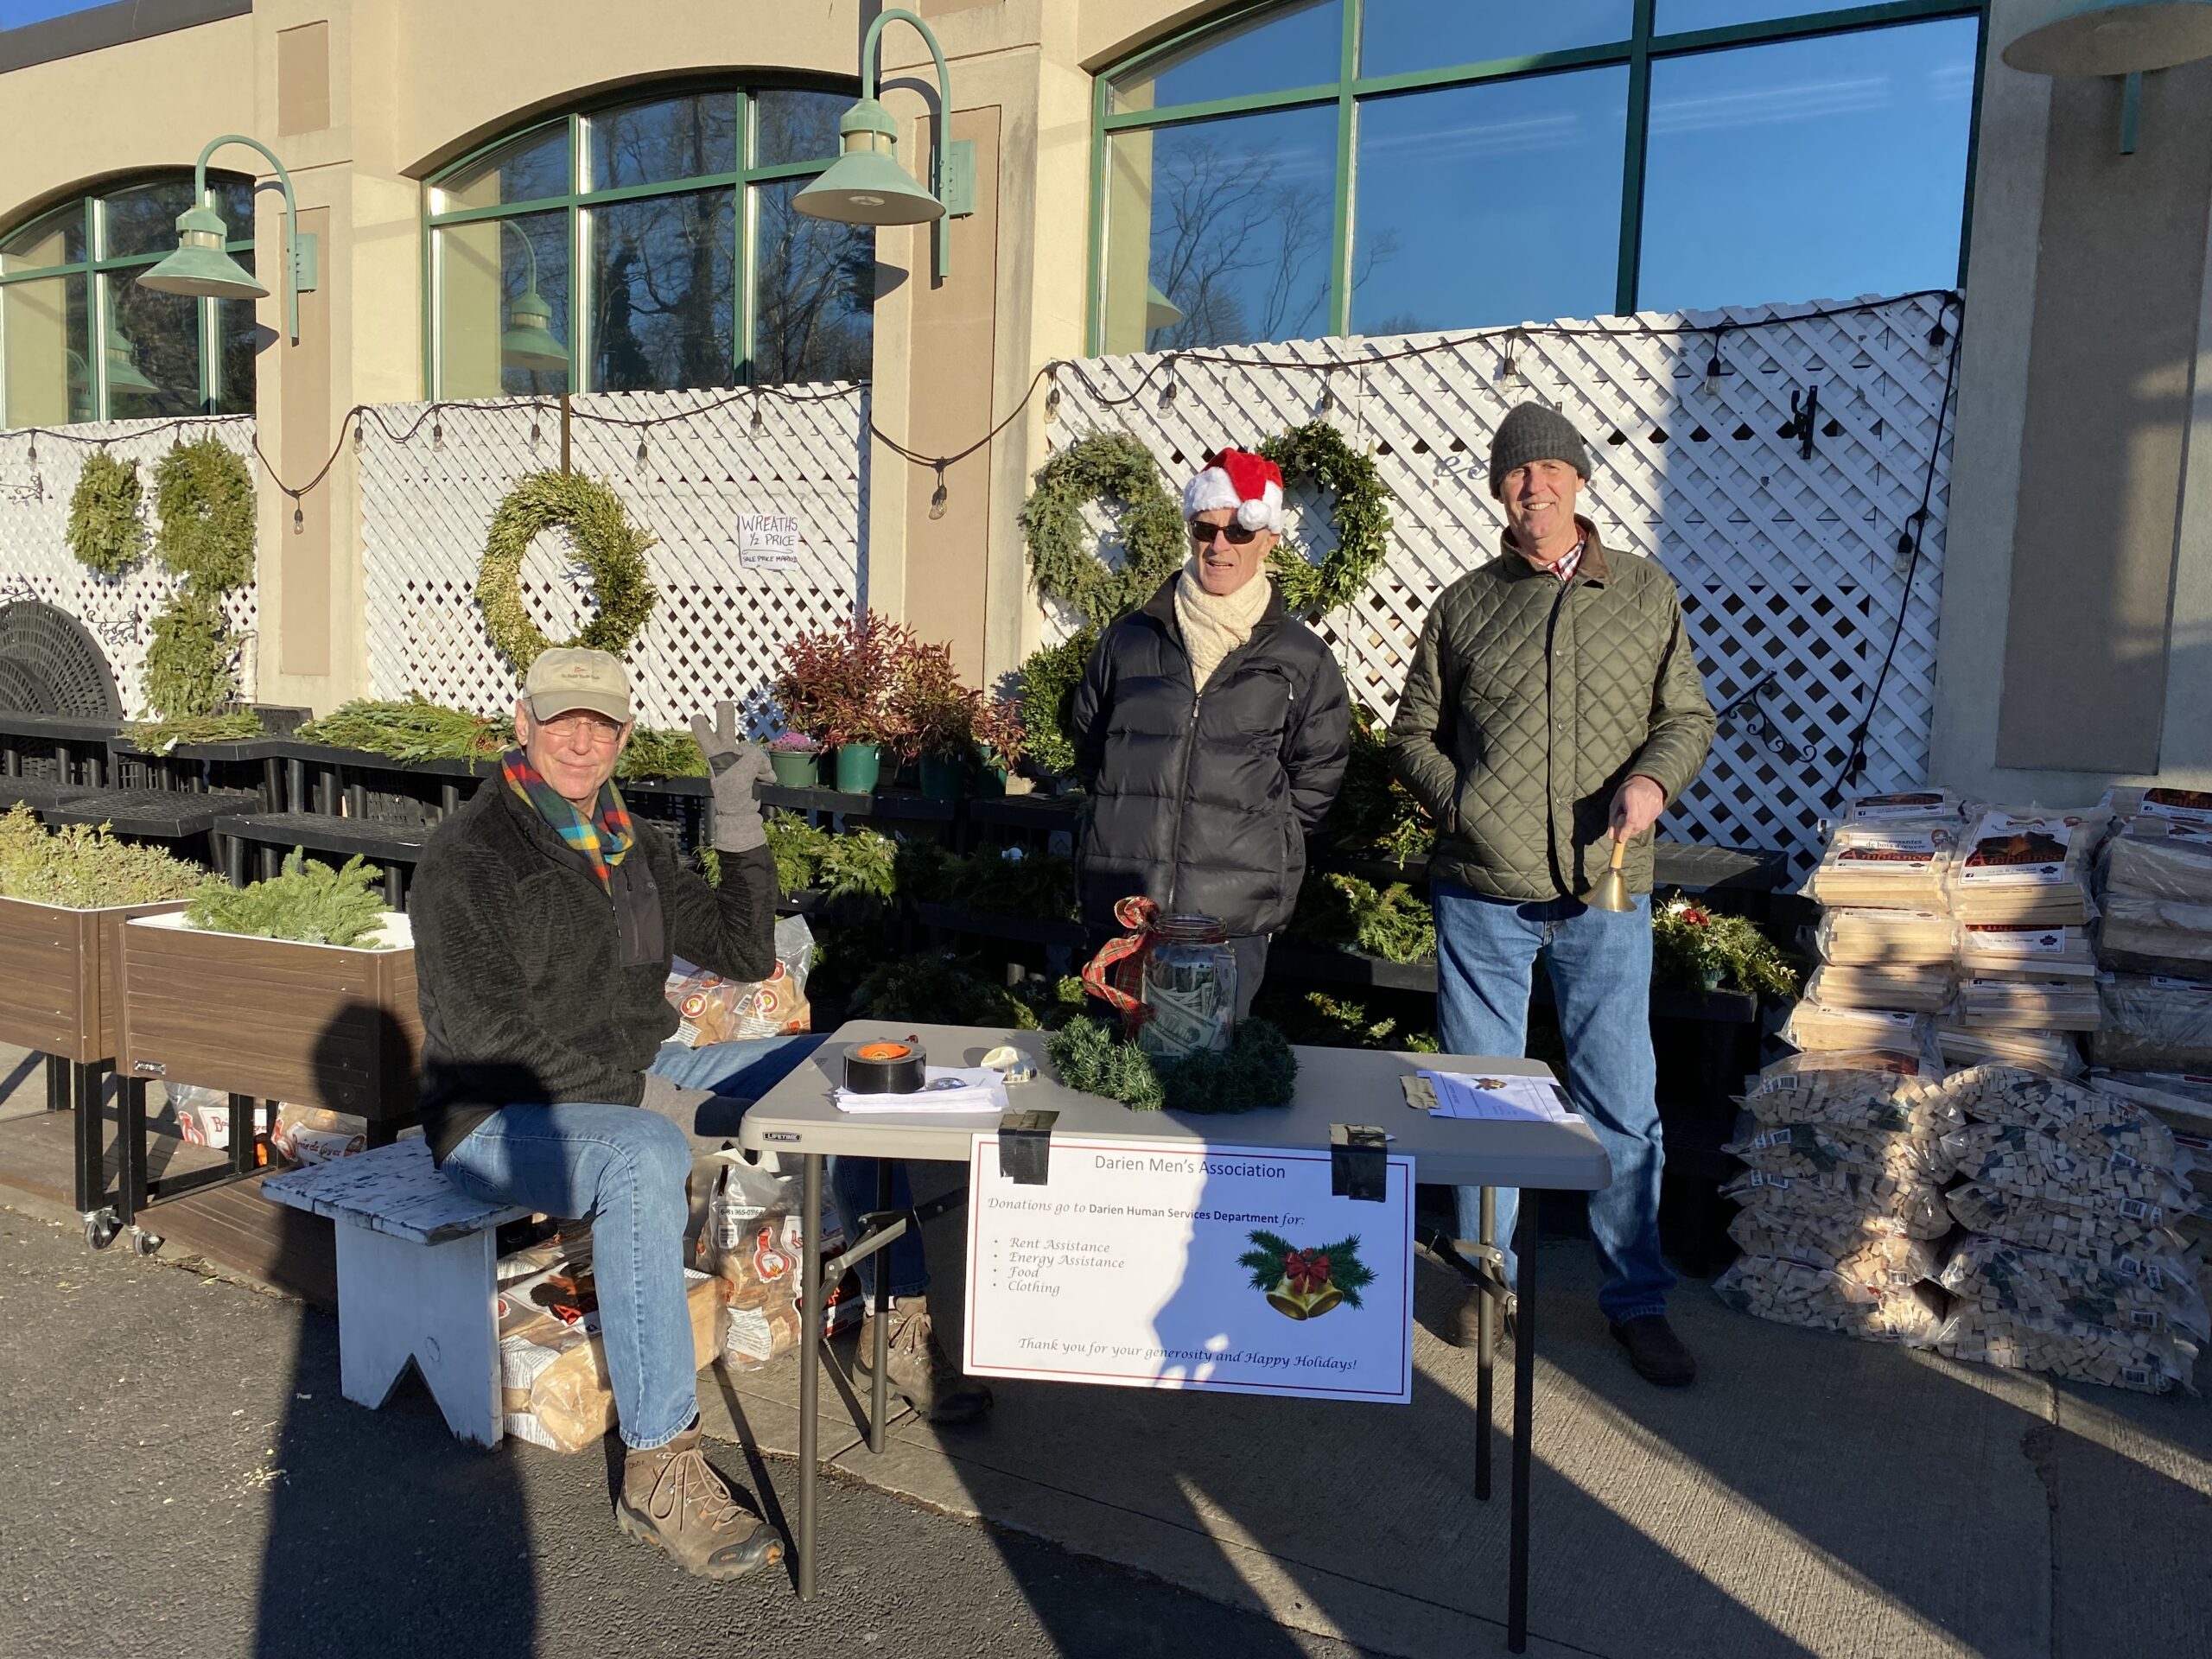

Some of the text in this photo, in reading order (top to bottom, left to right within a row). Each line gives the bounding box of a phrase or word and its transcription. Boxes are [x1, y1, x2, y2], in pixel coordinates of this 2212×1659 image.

[741, 514, 798, 532] WREATHS
[765, 533, 796, 546] PRICE
[1966, 849, 2063, 867] Ambiance
[1095, 1155, 1286, 1179] Darien Men's Association
[988, 1198, 1306, 1227] Donations go to Darien Human Services Department for:
[1009, 1237, 1110, 1253] Rent Assistance
[1009, 1252, 1125, 1268] Energy Assistance
[1007, 1266, 1040, 1279] Food
[1008, 1280, 1061, 1297] Clothing
[1019, 1338, 1357, 1372] Thank you for your generosity and Happy Holidays!
